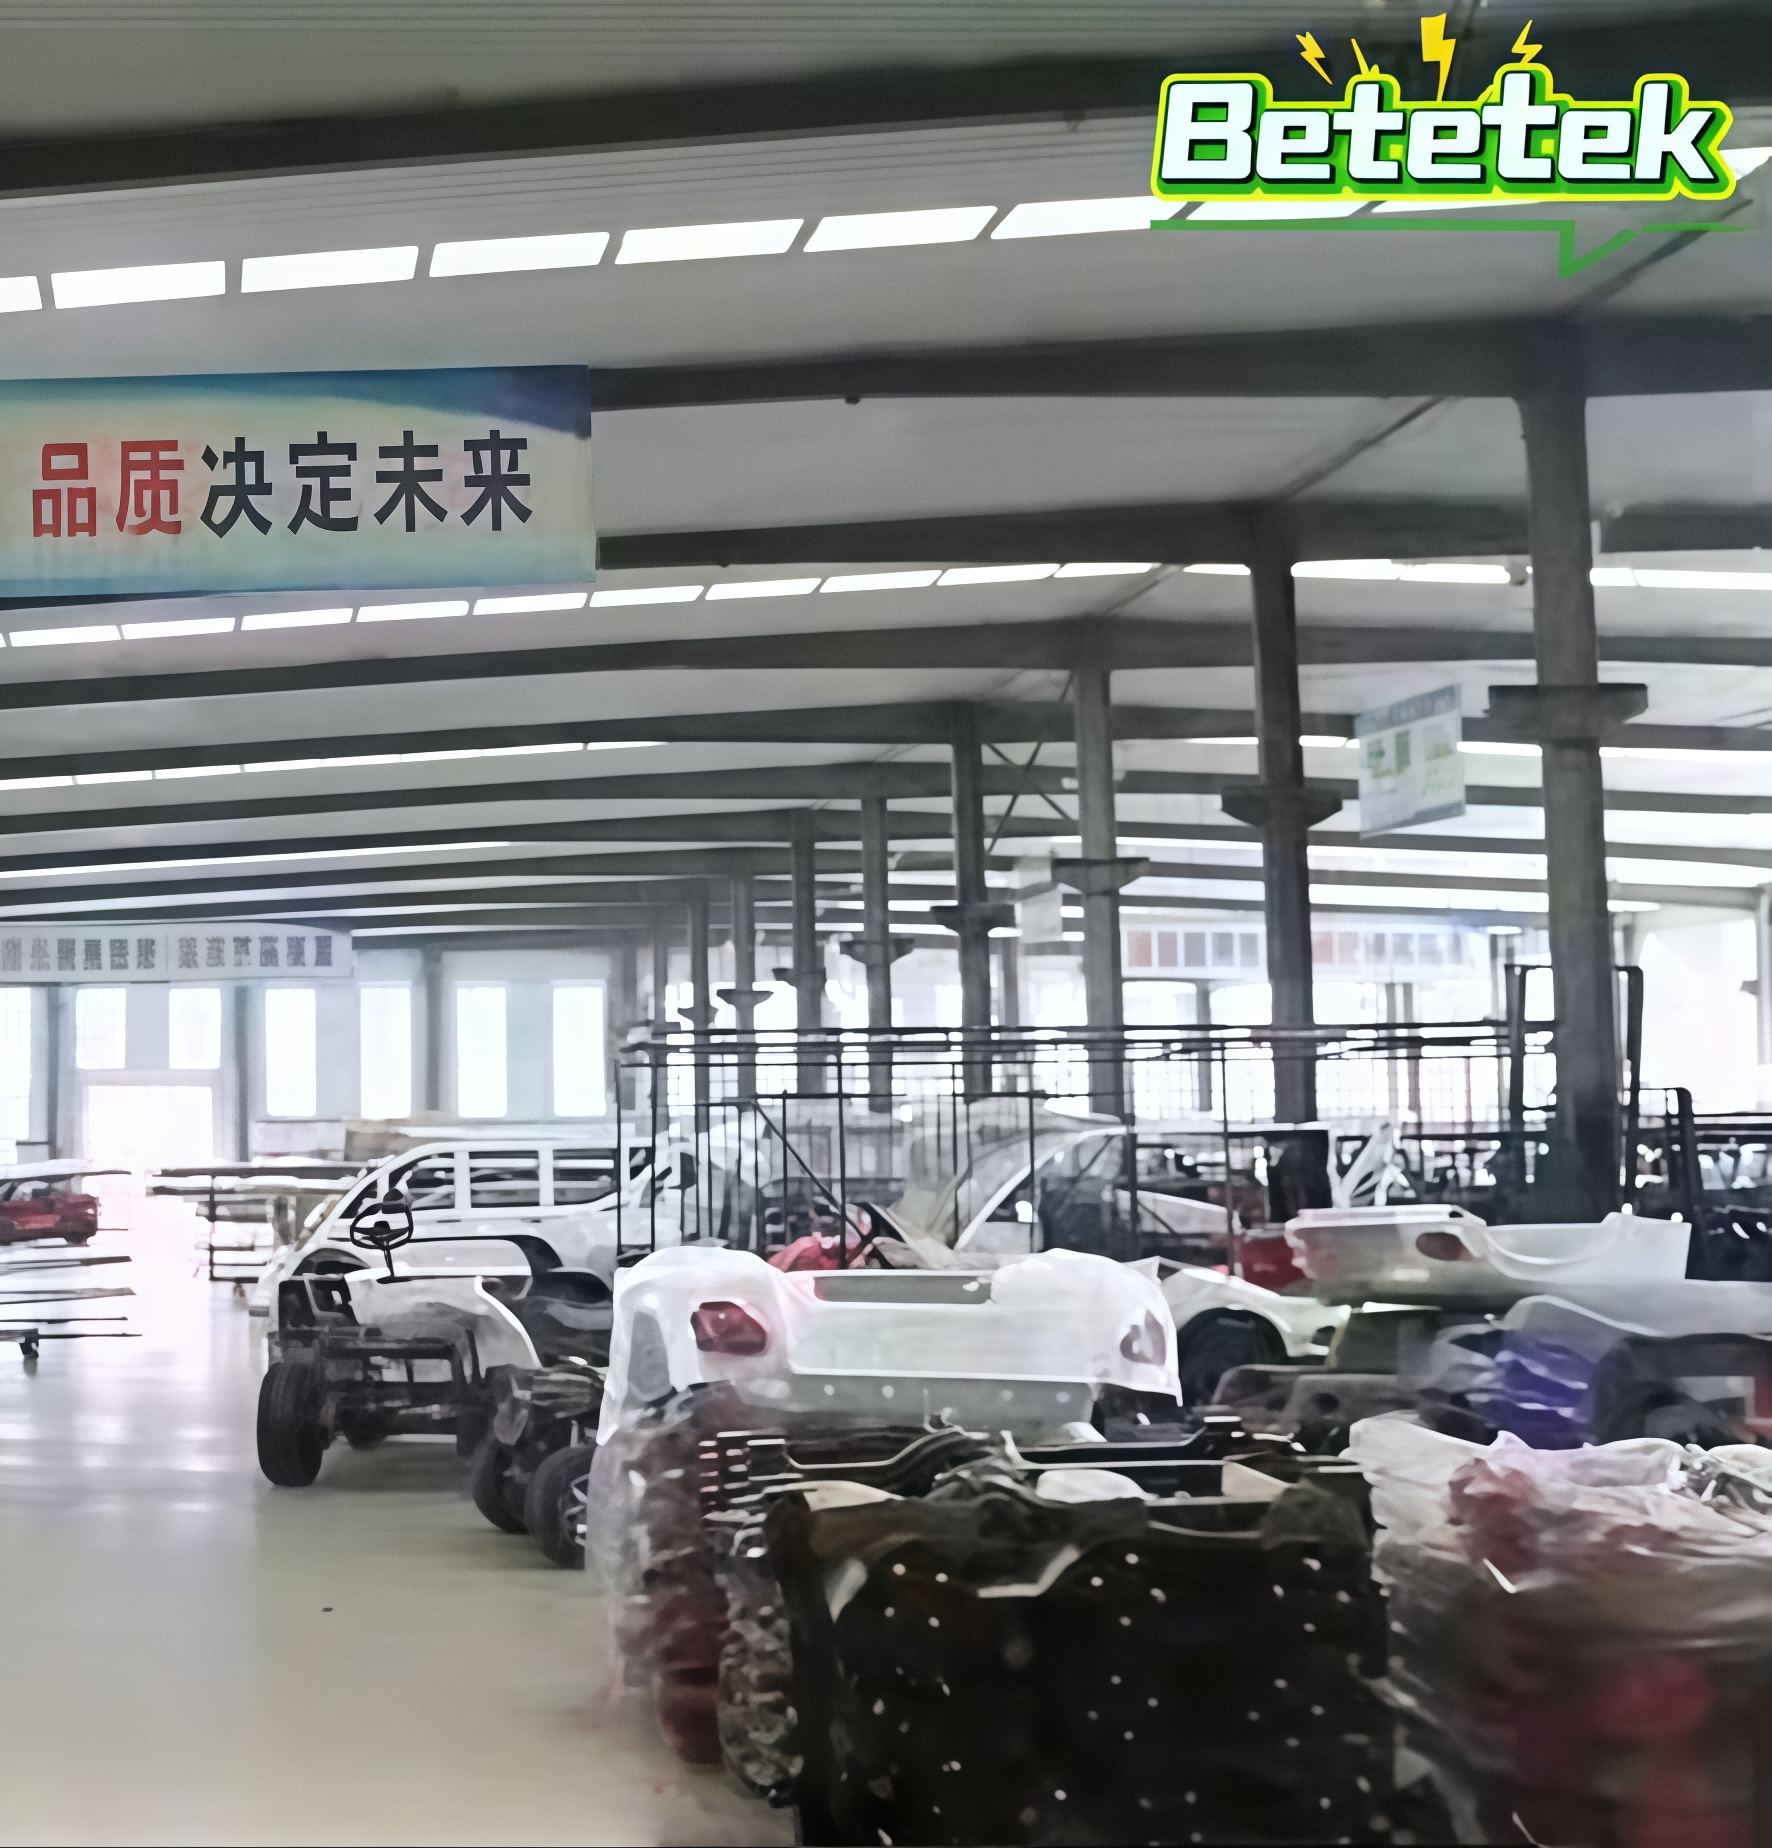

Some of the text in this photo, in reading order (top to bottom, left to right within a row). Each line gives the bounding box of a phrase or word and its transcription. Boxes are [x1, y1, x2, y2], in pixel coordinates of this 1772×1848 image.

[32, 429, 533, 538] 品质决定未来
